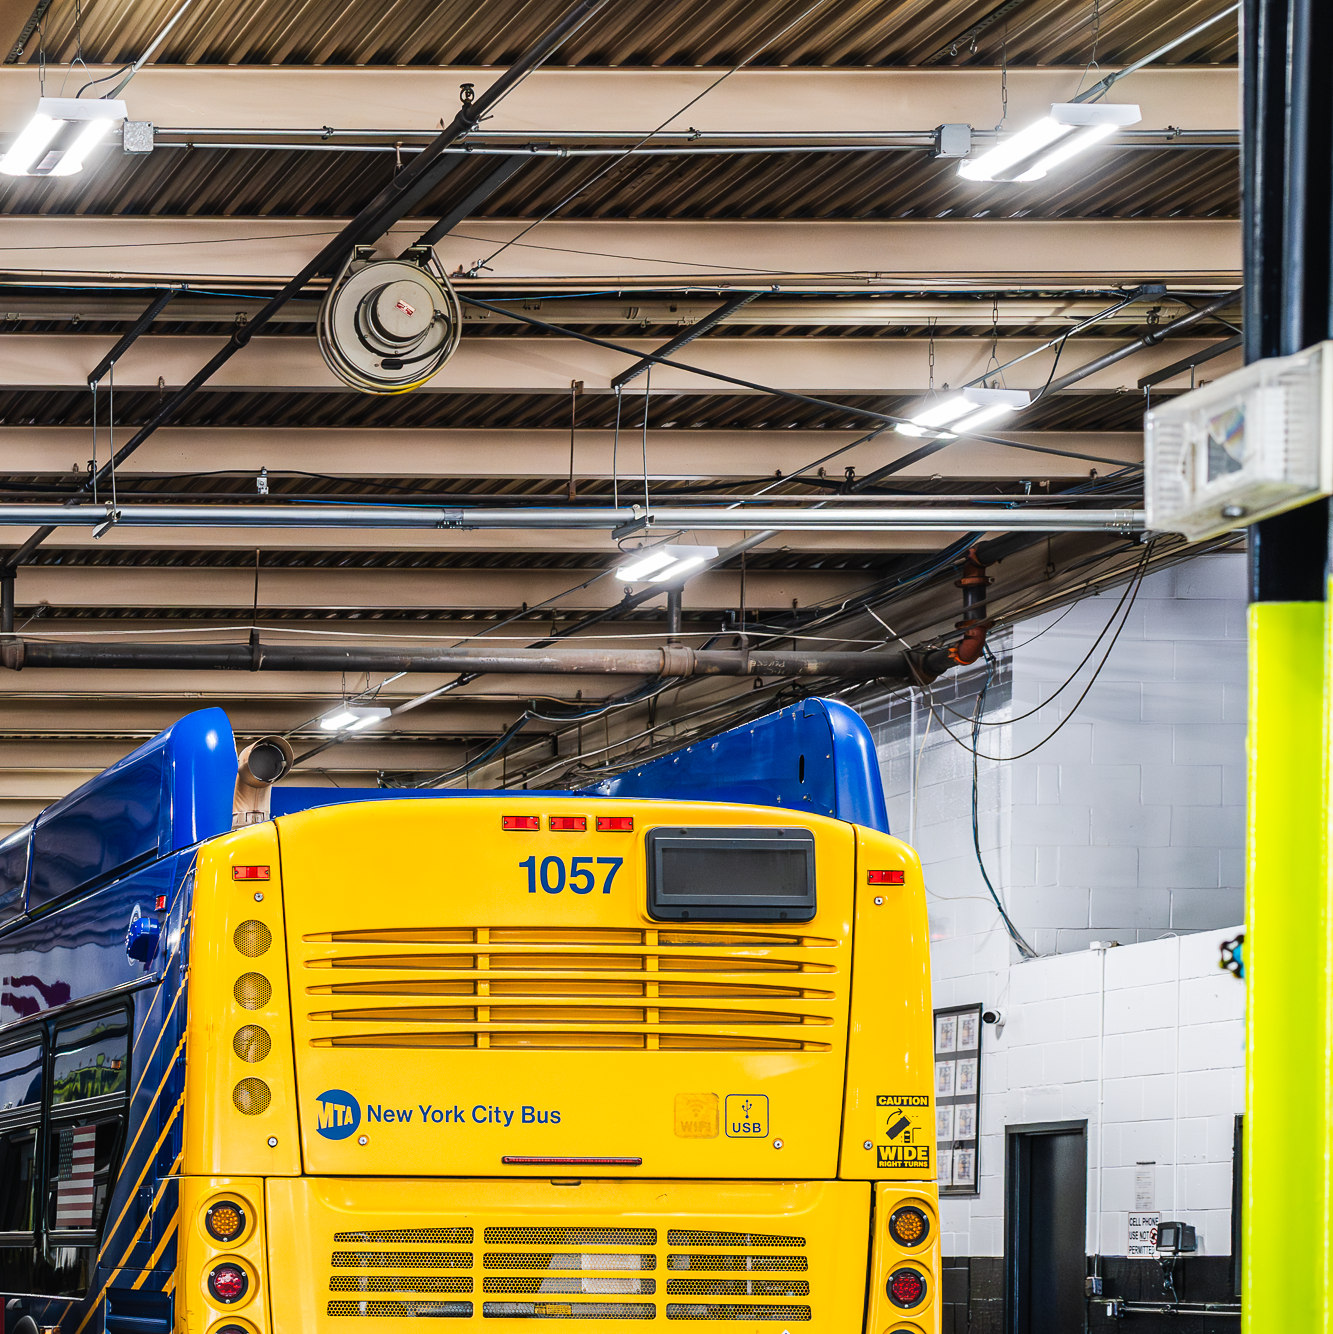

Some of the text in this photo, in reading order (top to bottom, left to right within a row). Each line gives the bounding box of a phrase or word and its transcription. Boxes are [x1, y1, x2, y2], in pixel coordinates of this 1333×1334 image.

[518, 856, 624, 895] 1057
[878, 1096, 928, 1106] CAUTION
[367, 1104, 561, 1127] New York City Bus
[732, 1122, 762, 1133] USB
[879, 1146, 928, 1160] WIDE
[1129, 1217, 1159, 1226] CELL PHONE
[1129, 1231, 1149, 1240] USE NOT
